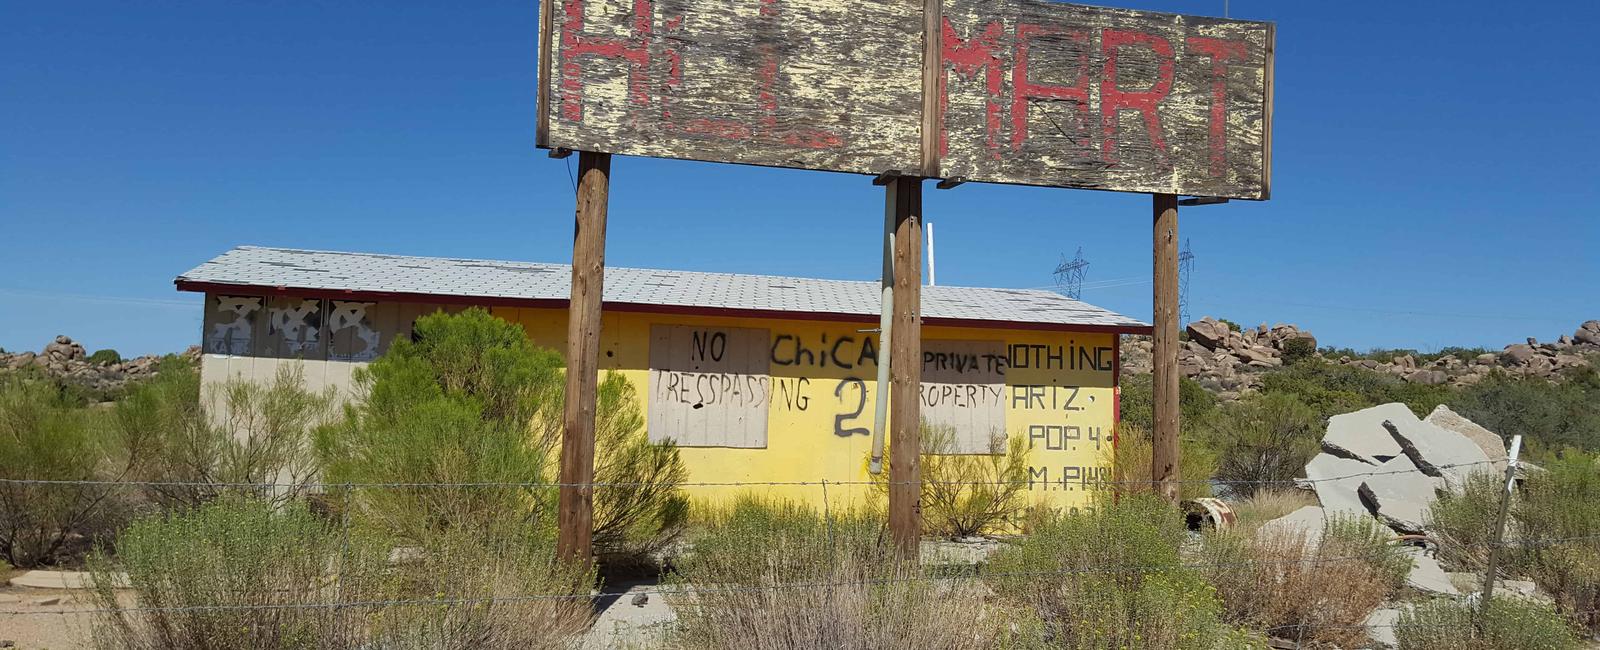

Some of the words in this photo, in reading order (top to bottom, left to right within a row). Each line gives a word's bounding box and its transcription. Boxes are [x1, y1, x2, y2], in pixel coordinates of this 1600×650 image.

[941, 16, 1247, 178] MART
[692, 331, 726, 362] NO
[771, 333, 880, 369] ChiCA
[923, 351, 1006, 376] PRIVATE
[656, 368, 811, 411] TRESSPASSING
[919, 384, 1003, 409] ROPERTY
[834, 376, 870, 437] 2
[1029, 425, 1081, 451] POP.
[1088, 426, 1101, 451] 4
